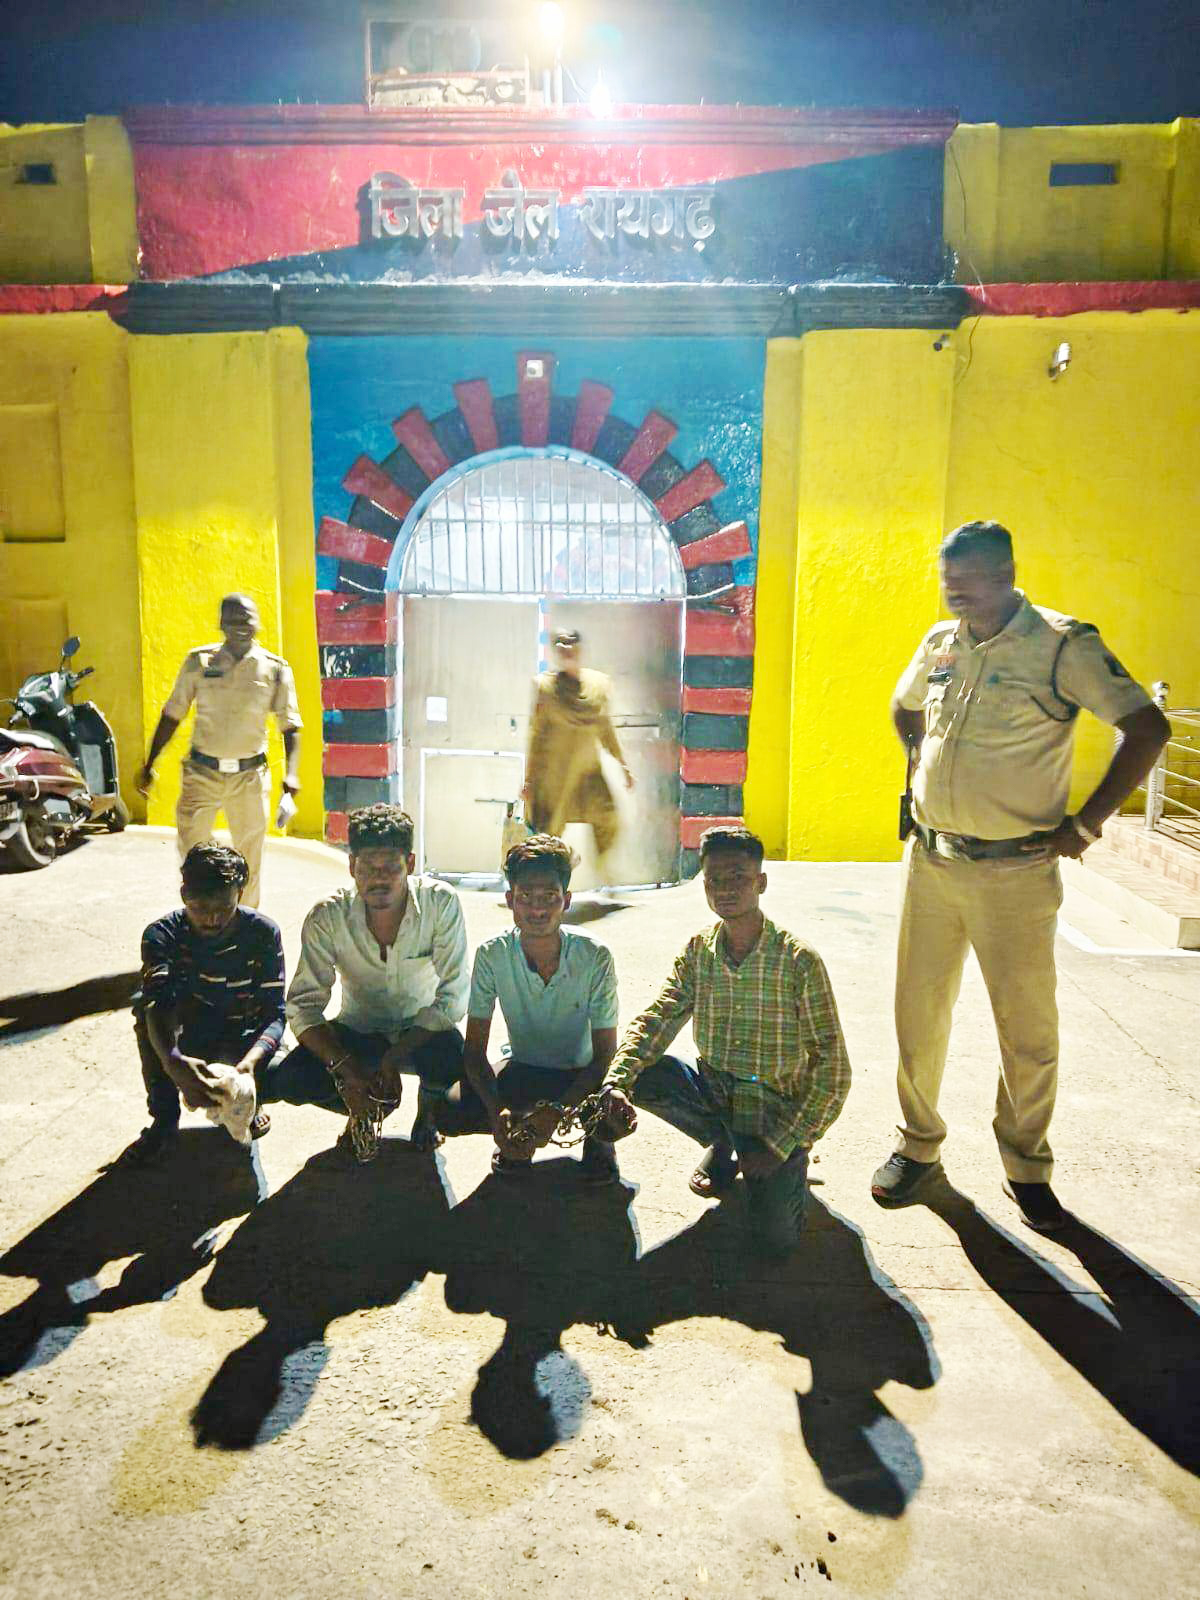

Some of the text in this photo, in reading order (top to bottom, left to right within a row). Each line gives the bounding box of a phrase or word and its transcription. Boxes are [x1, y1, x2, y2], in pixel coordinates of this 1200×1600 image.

[368, 169, 715, 252] जिला जेल रायगढ़
